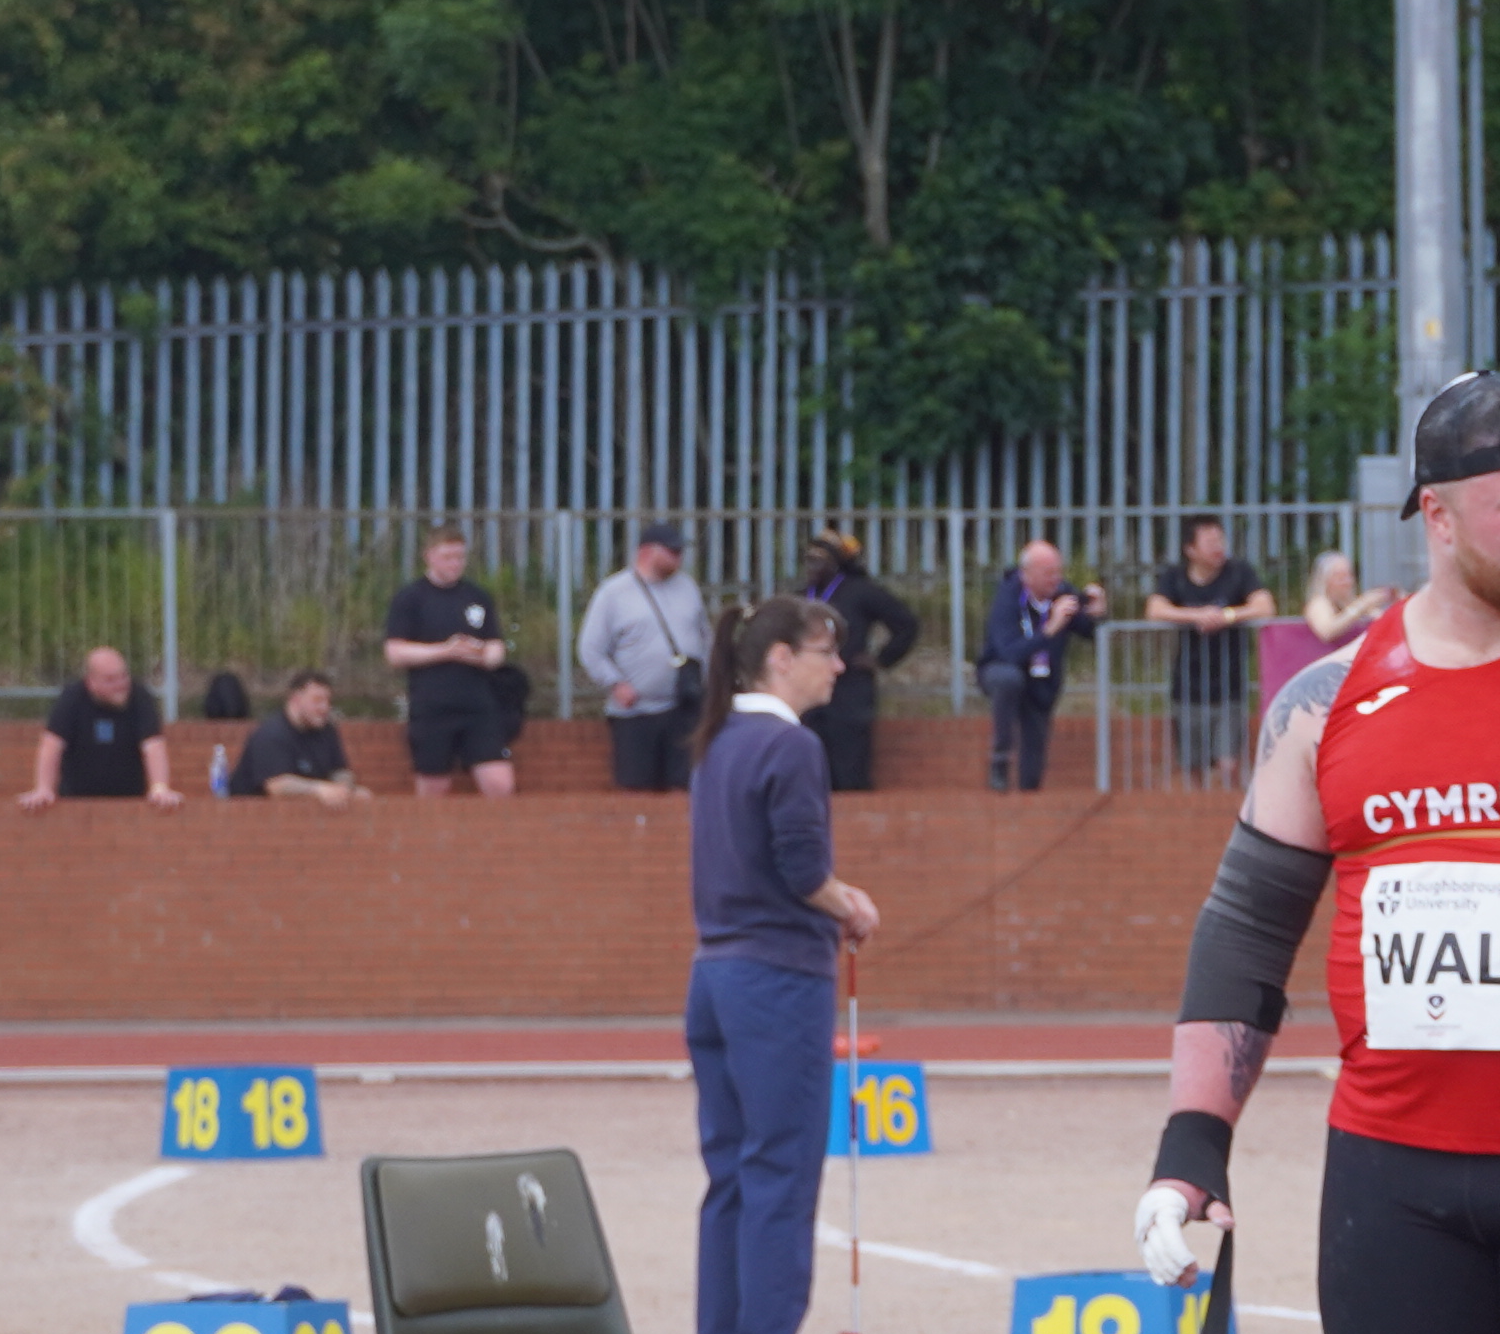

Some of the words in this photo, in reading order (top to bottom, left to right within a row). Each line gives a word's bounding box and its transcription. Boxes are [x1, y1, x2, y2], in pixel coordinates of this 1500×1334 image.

[172, 1076, 221, 1151] 18
[241, 1075, 309, 1150] 18
[853, 1075, 918, 1146] 16
